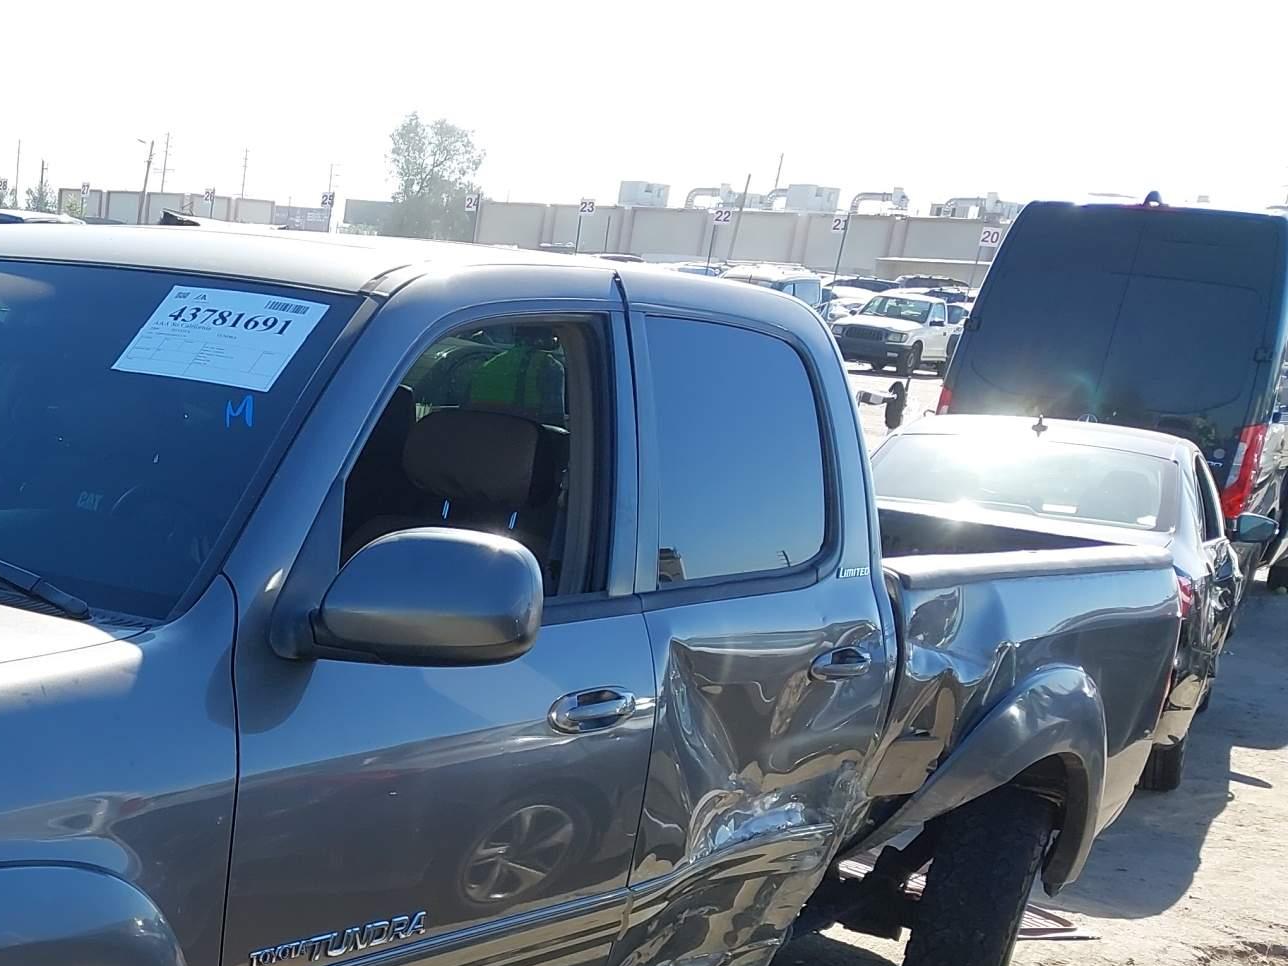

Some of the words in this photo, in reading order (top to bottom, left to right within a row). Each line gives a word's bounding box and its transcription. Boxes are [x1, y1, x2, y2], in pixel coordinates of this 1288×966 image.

[466, 197, 480, 209] 24
[579, 201, 595, 213] 23
[714, 210, 732, 222] 22
[832, 218, 848, 231] 21
[980, 230, 1000, 244] 20
[168, 305, 293, 337] 43781691
[225, 394, 254, 428] M
[307, 911, 427, 962] TUNDRA
